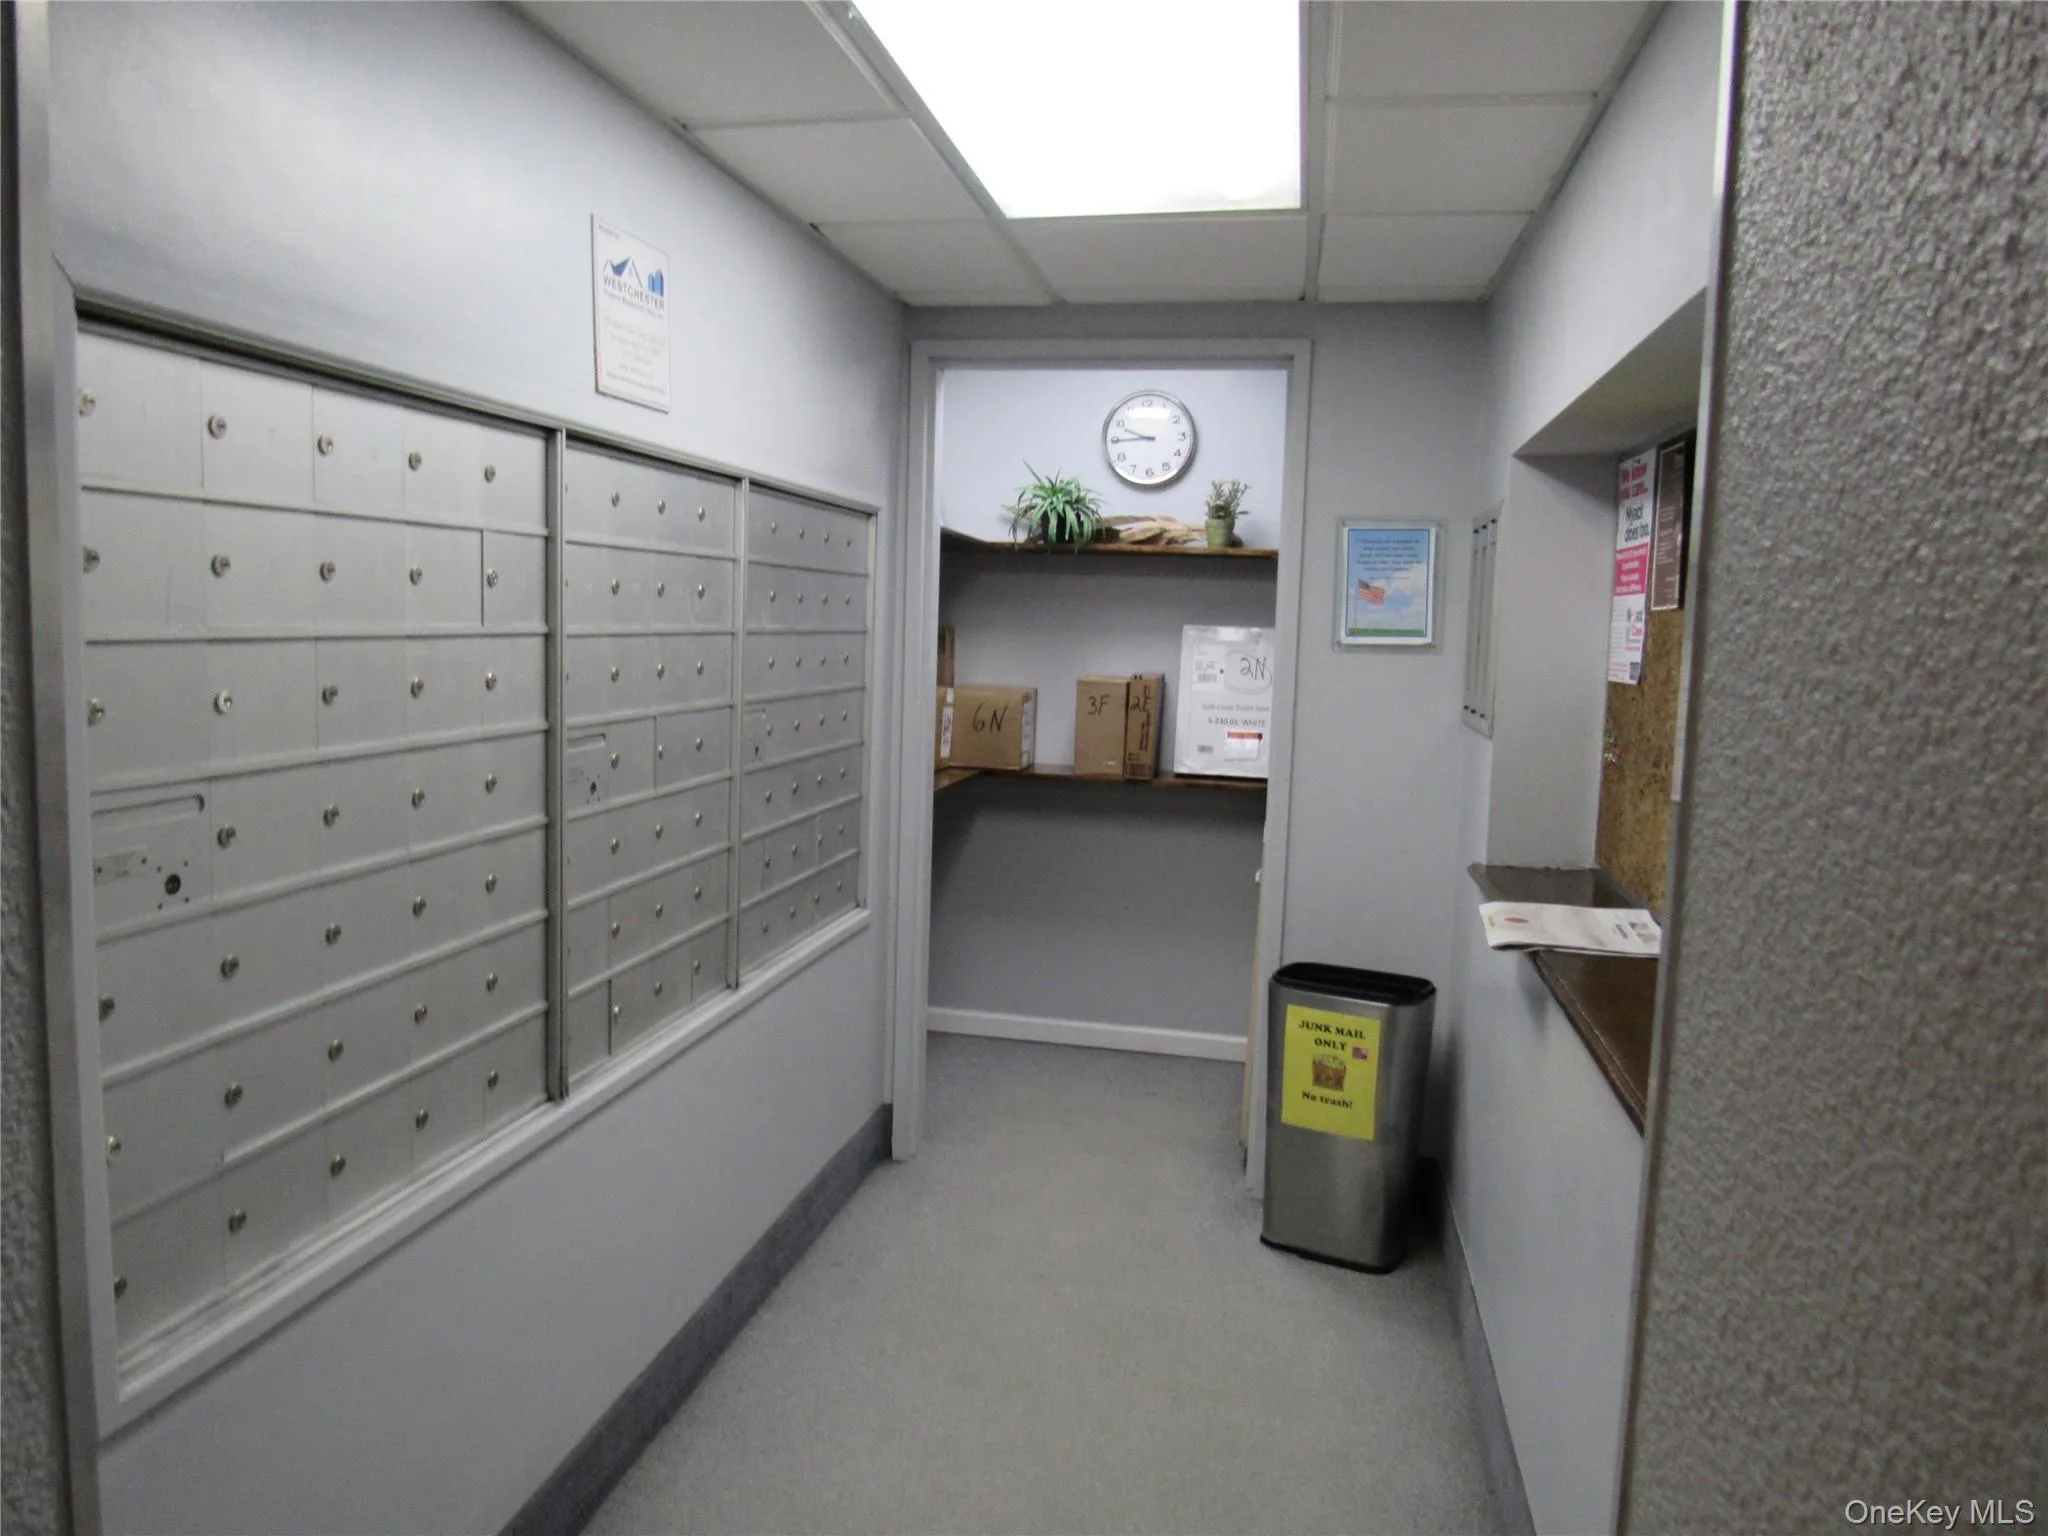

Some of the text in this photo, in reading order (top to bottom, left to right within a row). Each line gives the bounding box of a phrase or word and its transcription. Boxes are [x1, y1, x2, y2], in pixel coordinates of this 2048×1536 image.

[602, 273, 664, 311] WESTCHESTER
[1142, 400, 1153, 408] 12
[1115, 420, 1125, 428] 10
[1172, 415, 1181, 424] 2
[1177, 432, 1187, 442] 3
[1129, 464, 1137, 473] 7
[1145, 468, 1154, 477] 6
[1240, 656, 1267, 681] 2N
[1087, 694, 1111, 716] 3F
[972, 703, 1009, 734] 6N
[1298, 1020, 1366, 1040] JUNK MAIL
[1314, 1038, 1347, 1052] ONLY
[1301, 1091, 1353, 1109] No trash!
